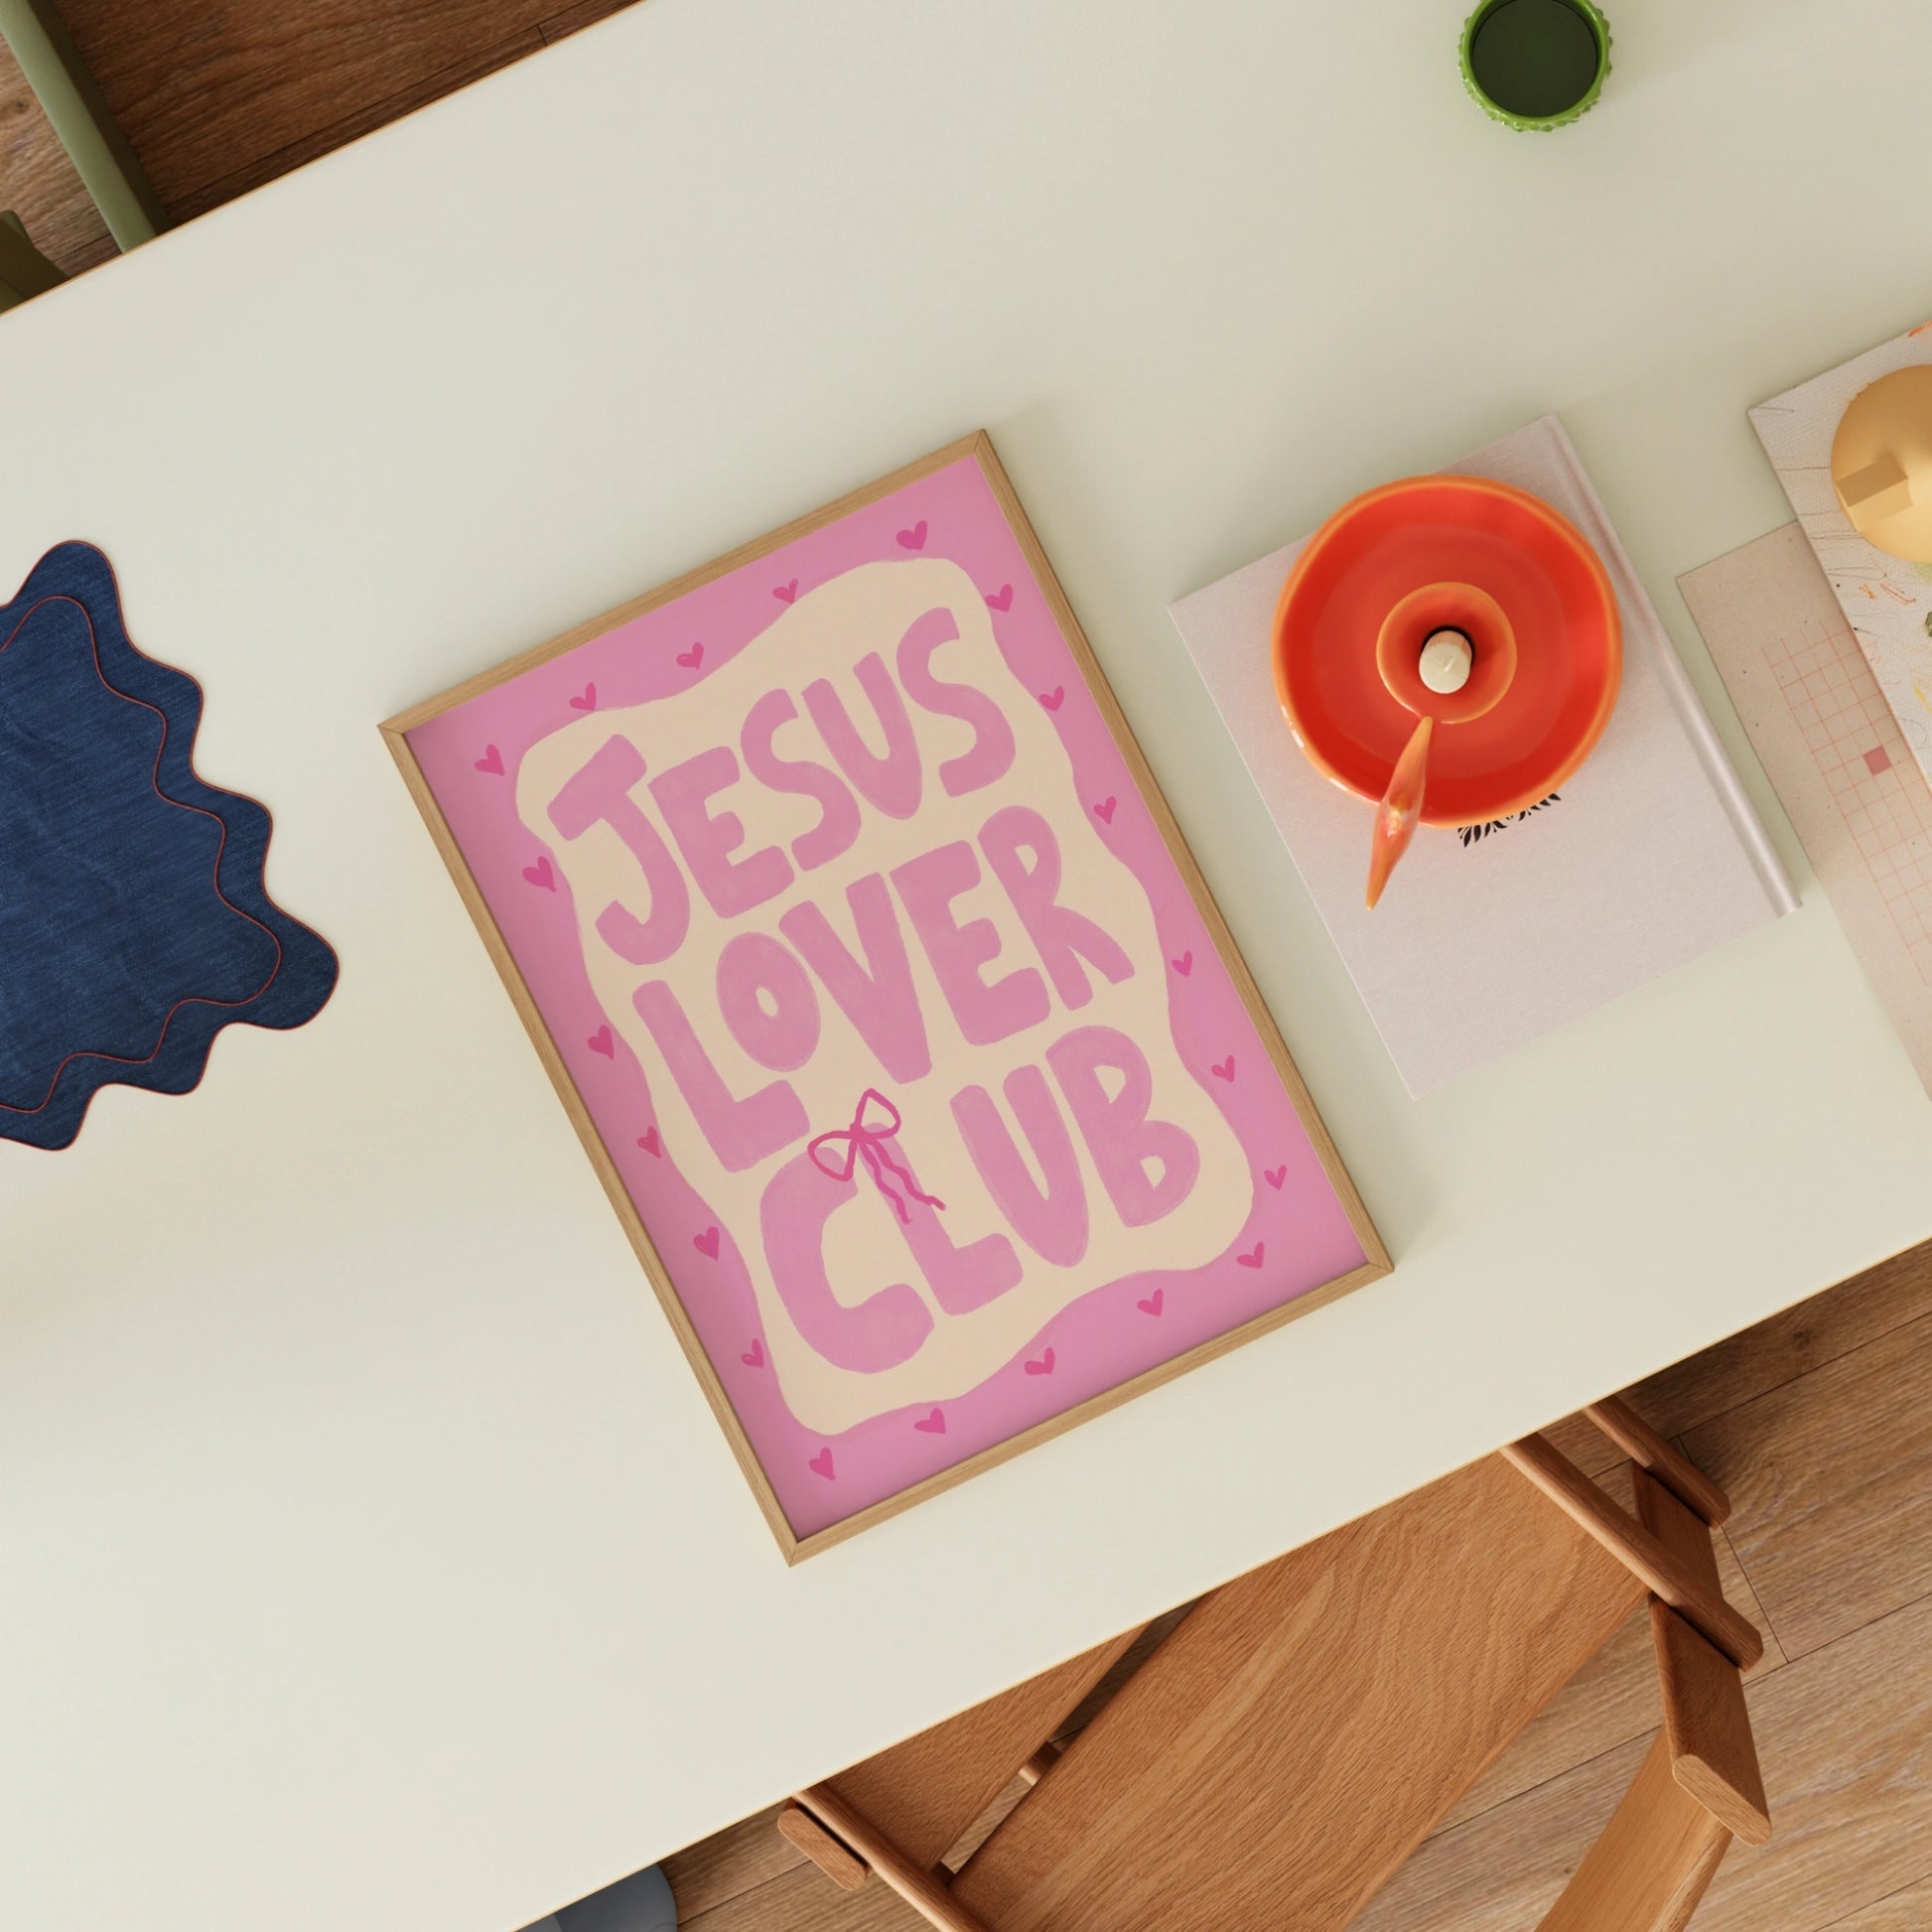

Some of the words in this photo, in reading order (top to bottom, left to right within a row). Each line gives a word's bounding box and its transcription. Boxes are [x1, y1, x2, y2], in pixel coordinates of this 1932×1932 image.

[547, 607, 1016, 966] JESUS
[632, 805, 1135, 1173] LOVER
[759, 1025, 1200, 1374] CLUB
